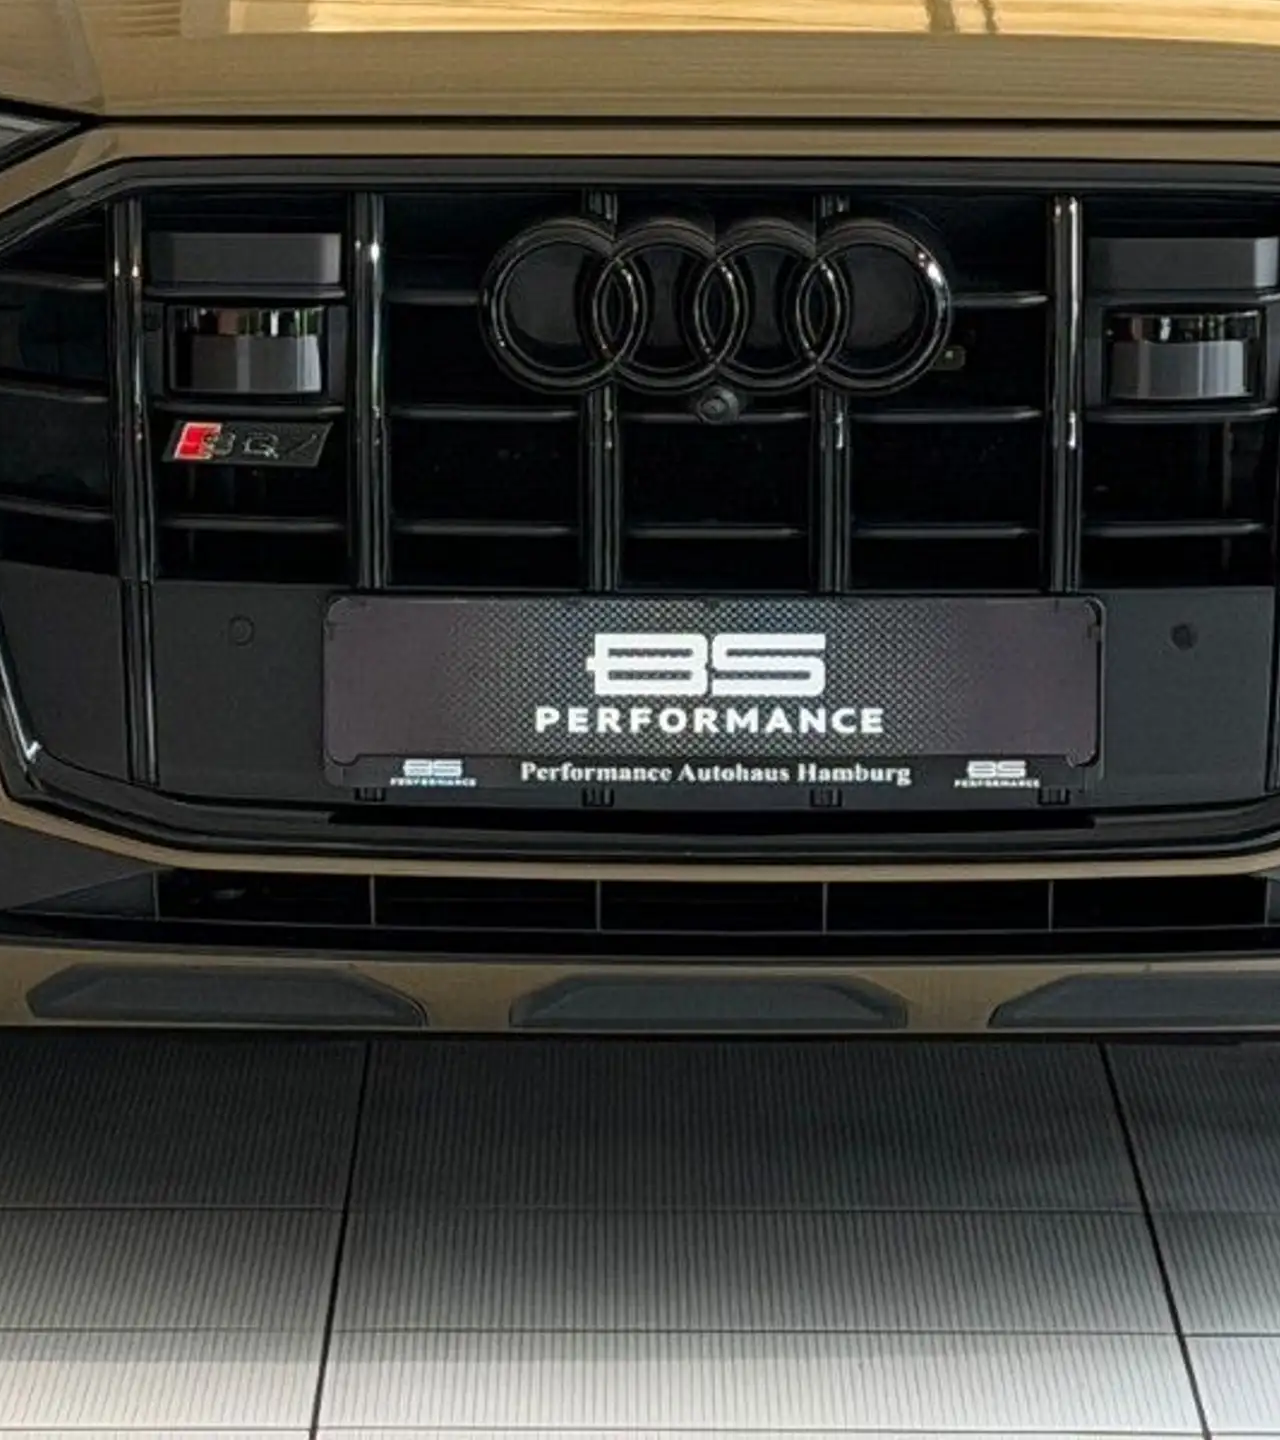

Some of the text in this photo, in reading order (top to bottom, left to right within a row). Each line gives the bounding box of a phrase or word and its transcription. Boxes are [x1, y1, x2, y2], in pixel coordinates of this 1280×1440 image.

[534, 704, 886, 736] PERFORMANCE
[521, 761, 913, 789] Performance Autohaus Hamburg
